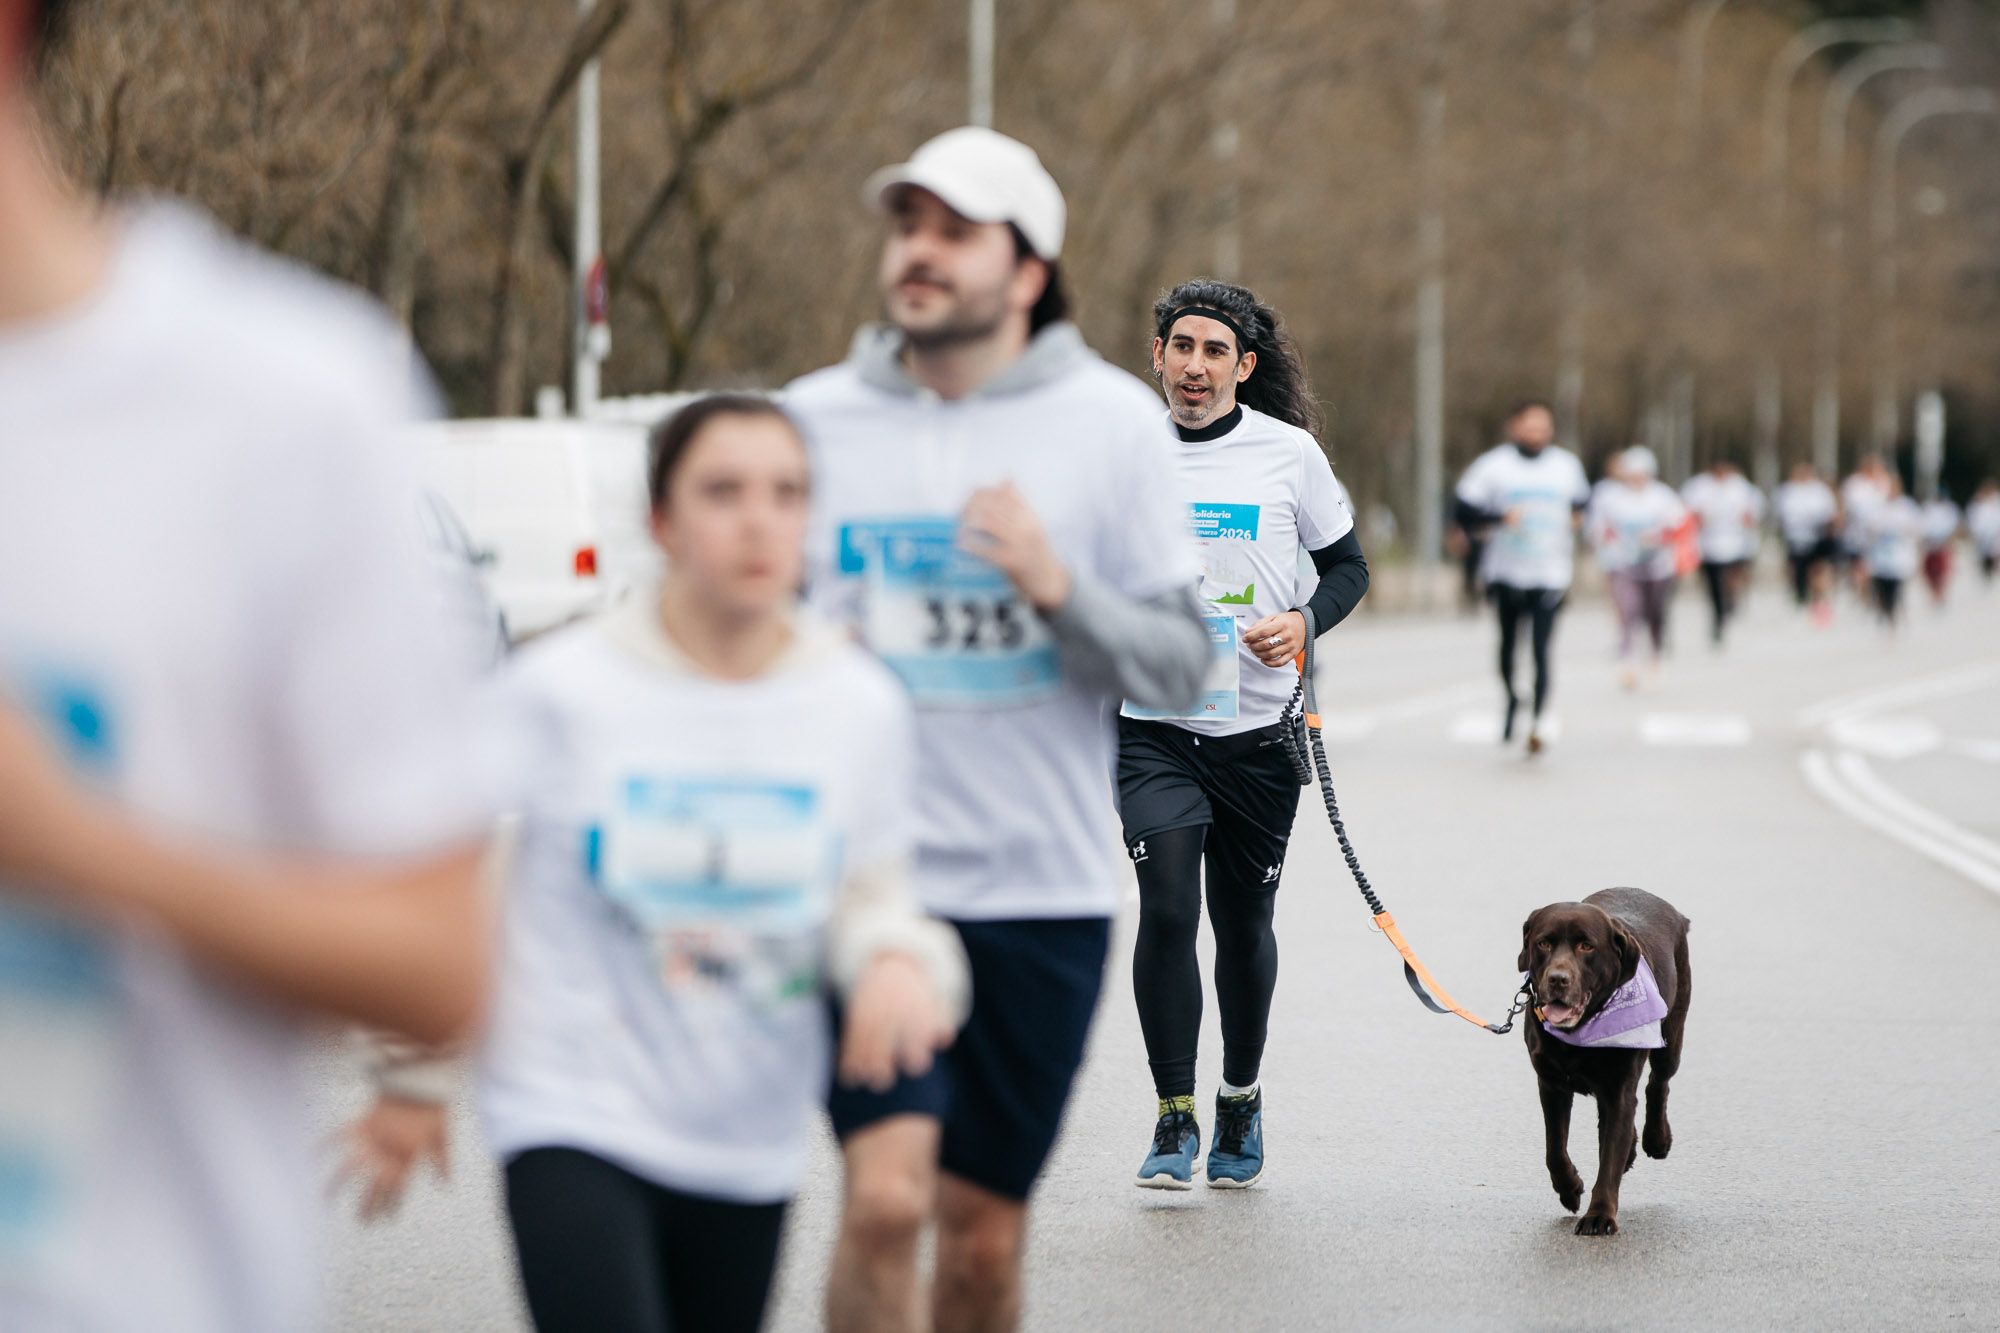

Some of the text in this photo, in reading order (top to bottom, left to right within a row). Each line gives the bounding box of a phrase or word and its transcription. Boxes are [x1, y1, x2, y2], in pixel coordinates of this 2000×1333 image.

[1190, 510, 1231, 519] Solidaria
[1219, 528, 1252, 540] 2026
[926, 599, 1024, 650] 325
